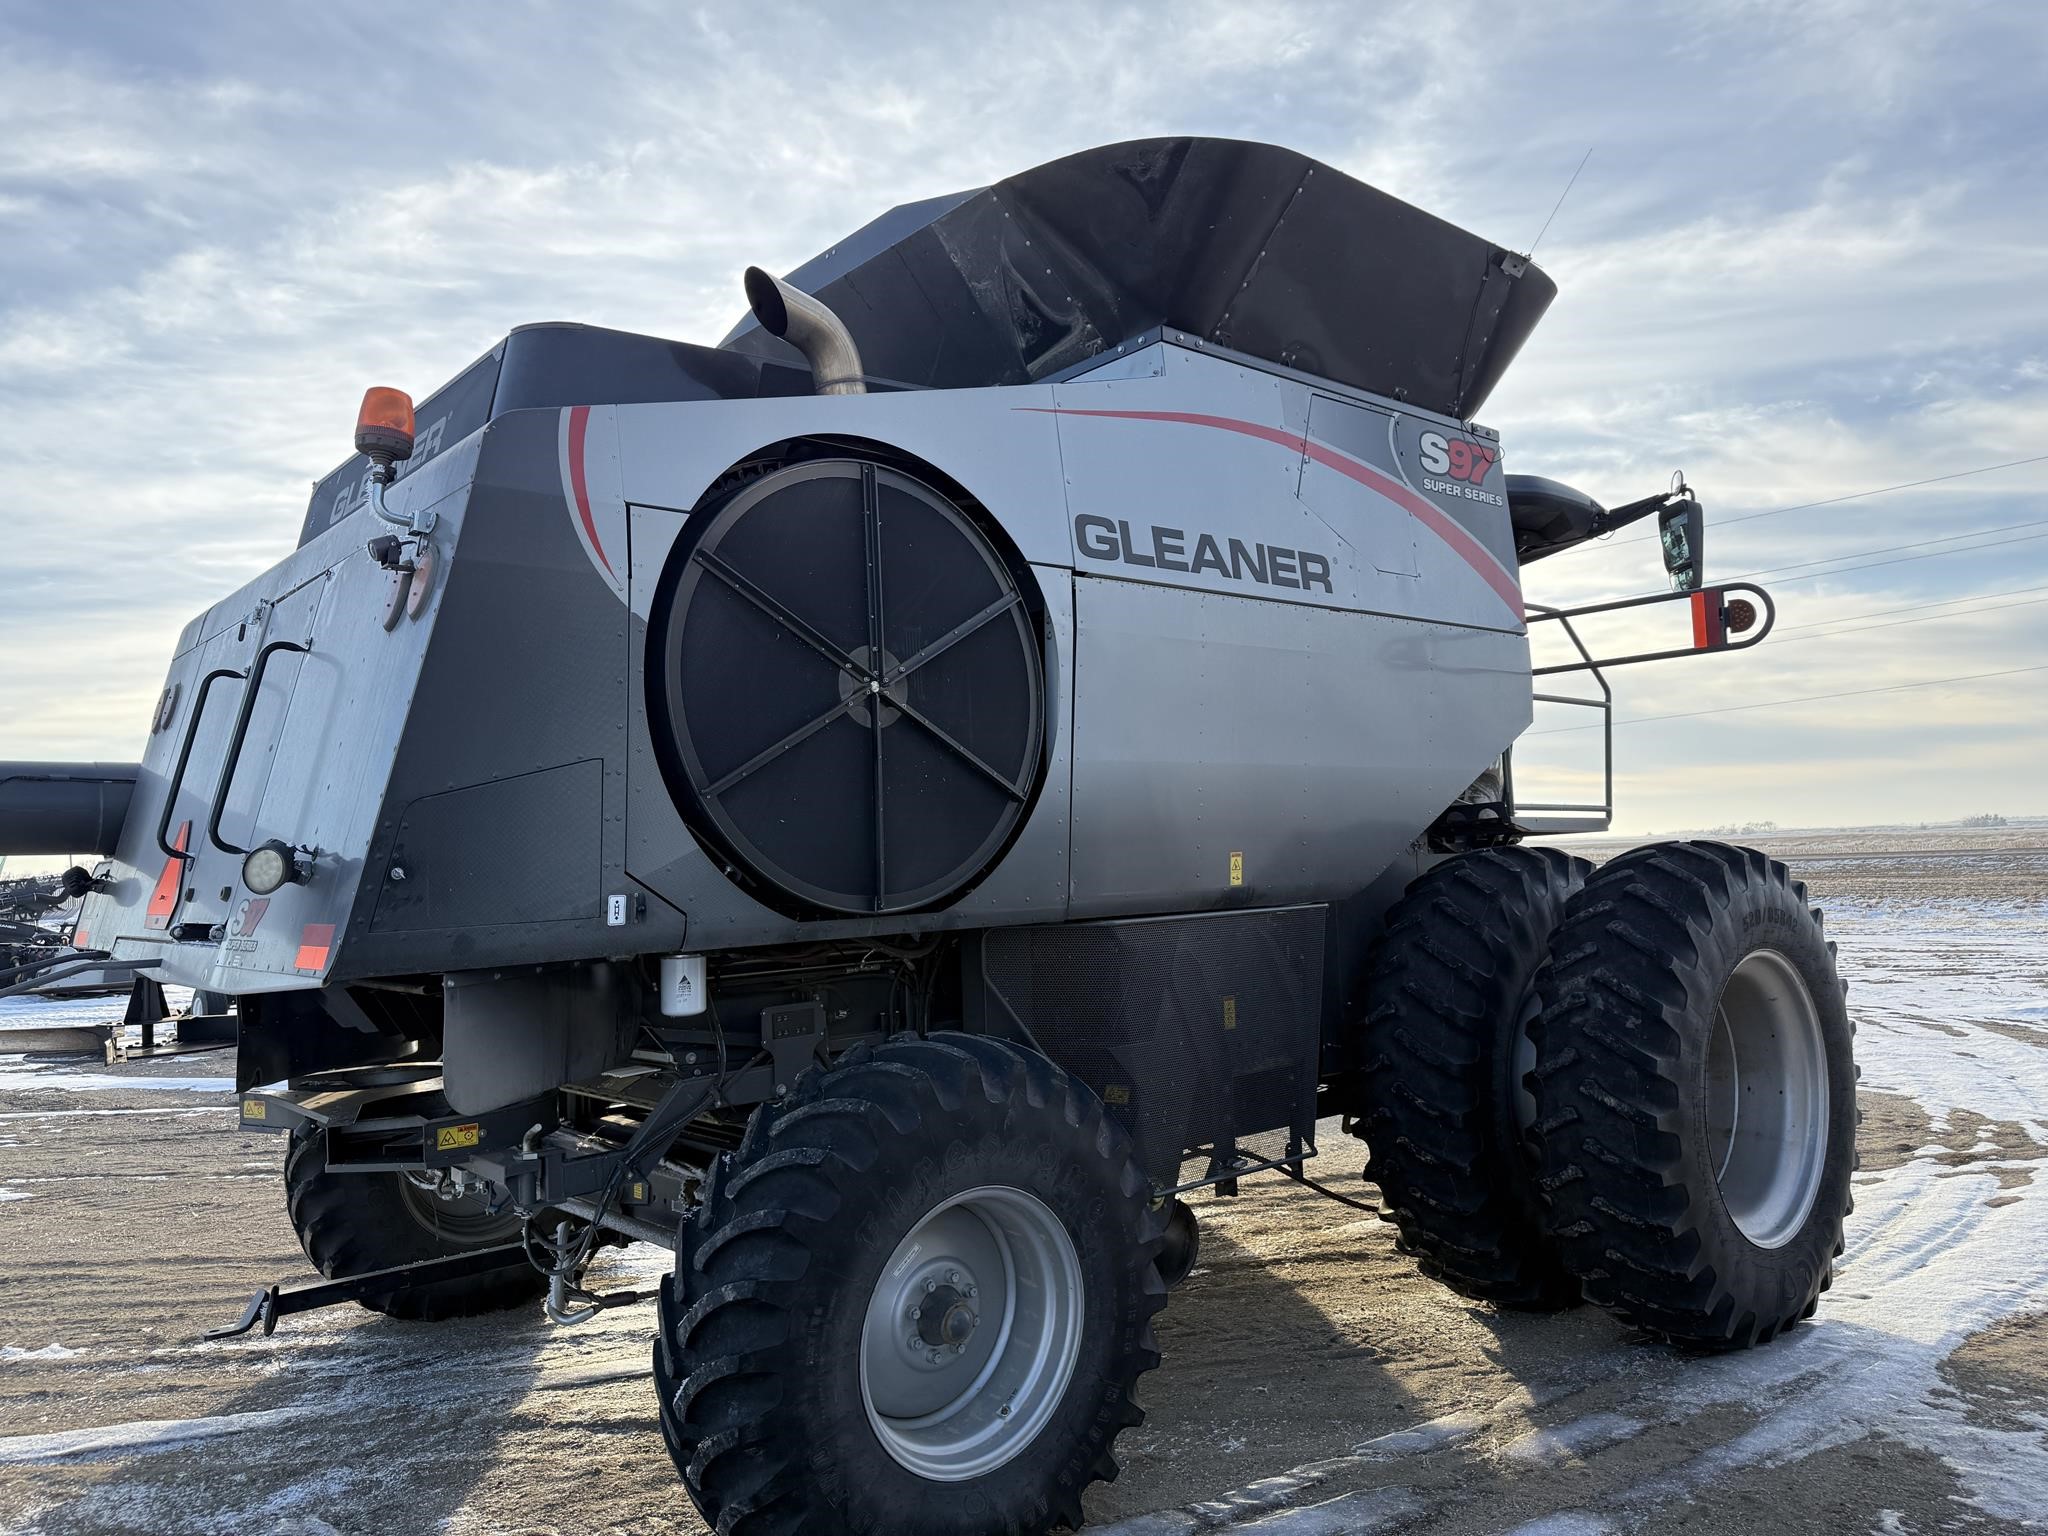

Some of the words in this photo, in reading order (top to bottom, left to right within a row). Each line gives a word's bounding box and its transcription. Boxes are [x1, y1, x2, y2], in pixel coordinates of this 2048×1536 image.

[1419, 429, 1496, 487] S97
[1423, 478, 1461, 497] SUPER
[1464, 487, 1503, 506] SERIES
[1074, 513, 1334, 594] GLEANER
